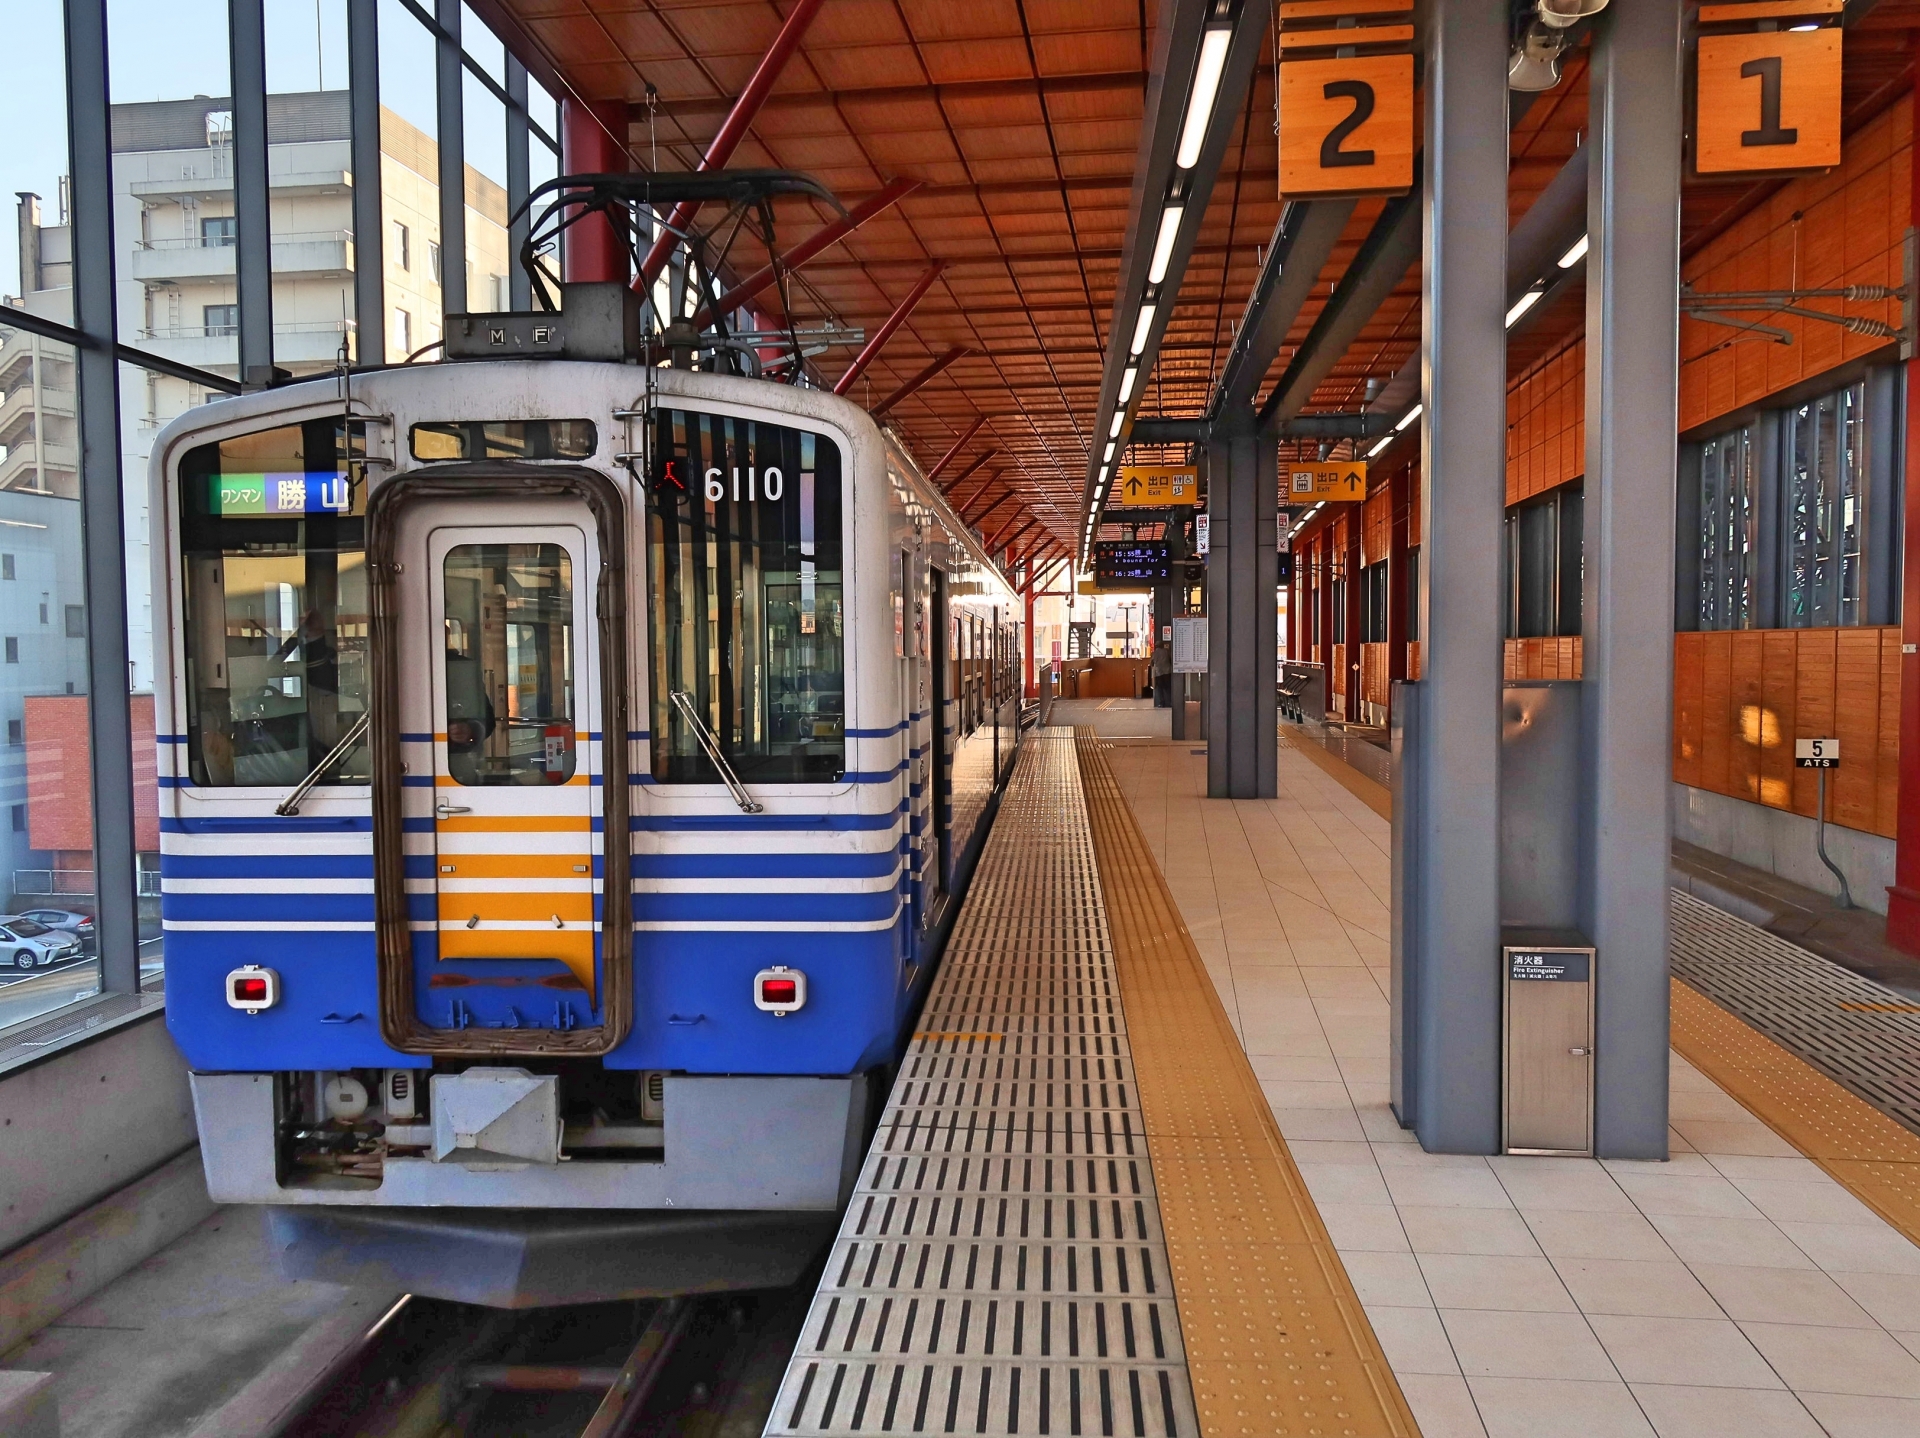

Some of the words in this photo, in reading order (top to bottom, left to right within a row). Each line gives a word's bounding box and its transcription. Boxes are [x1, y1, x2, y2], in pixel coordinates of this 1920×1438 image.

[1741, 56, 1797, 147] 1
[1320, 80, 1375, 168] 2
[491, 329, 504, 343] M
[535, 328, 548, 342] F
[1148, 476, 1168, 486] 出口
[1317, 472, 1338, 482] 出口
[704, 466, 783, 502] 6110
[221, 488, 262, 504] ワンマン
[277, 478, 349, 511] 勝山
[1148, 488, 1162, 496] Exit
[1161, 549, 1167, 557] 2
[1161, 569, 1167, 577] 2
[1812, 740, 1823, 757] 5
[1803, 759, 1830, 767] ATS
[1513, 955, 1543, 965] 消火器
